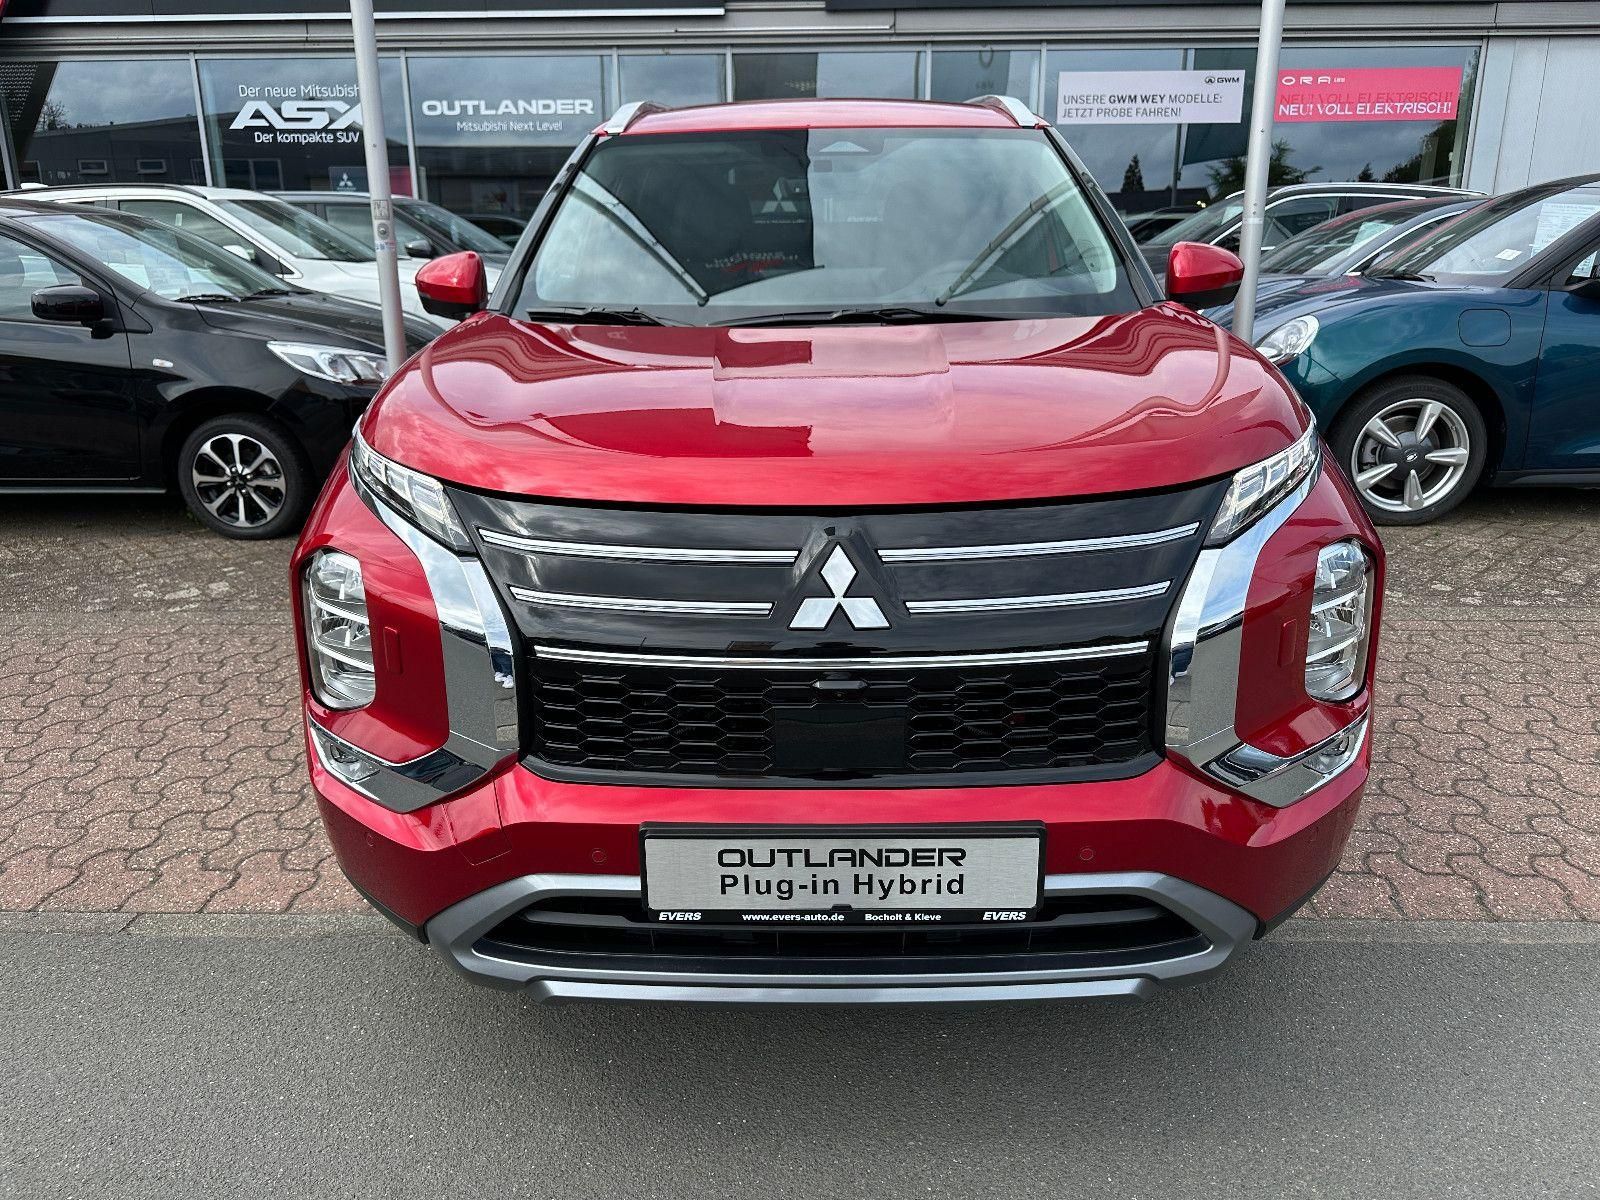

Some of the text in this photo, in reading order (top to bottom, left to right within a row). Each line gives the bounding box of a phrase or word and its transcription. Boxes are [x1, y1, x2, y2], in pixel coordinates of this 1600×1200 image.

[1216, 76, 1240, 84] GWM
[1281, 75, 1331, 86] ORA
[238, 84, 360, 98] Der neue Mitsubish
[1063, 93, 1223, 105] UNSERE GWM WEY MODELLE:
[421, 98, 595, 116] OUTLANDER
[1062, 106, 1181, 119] JETZT PROBE FAHREN!
[1278, 102, 1452, 116] NEU! VOLL ELEKTRISCH!
[456, 120, 562, 132] Mitsubishi Next Level
[254, 131, 360, 145] Der kompakte SUV
[717, 847, 967, 868] OUTLANDER
[720, 872, 965, 901] Plug-in Hybrid
[658, 911, 1027, 922] EVERS www.evers-auto.de Bocholt & Kleve EVERS
